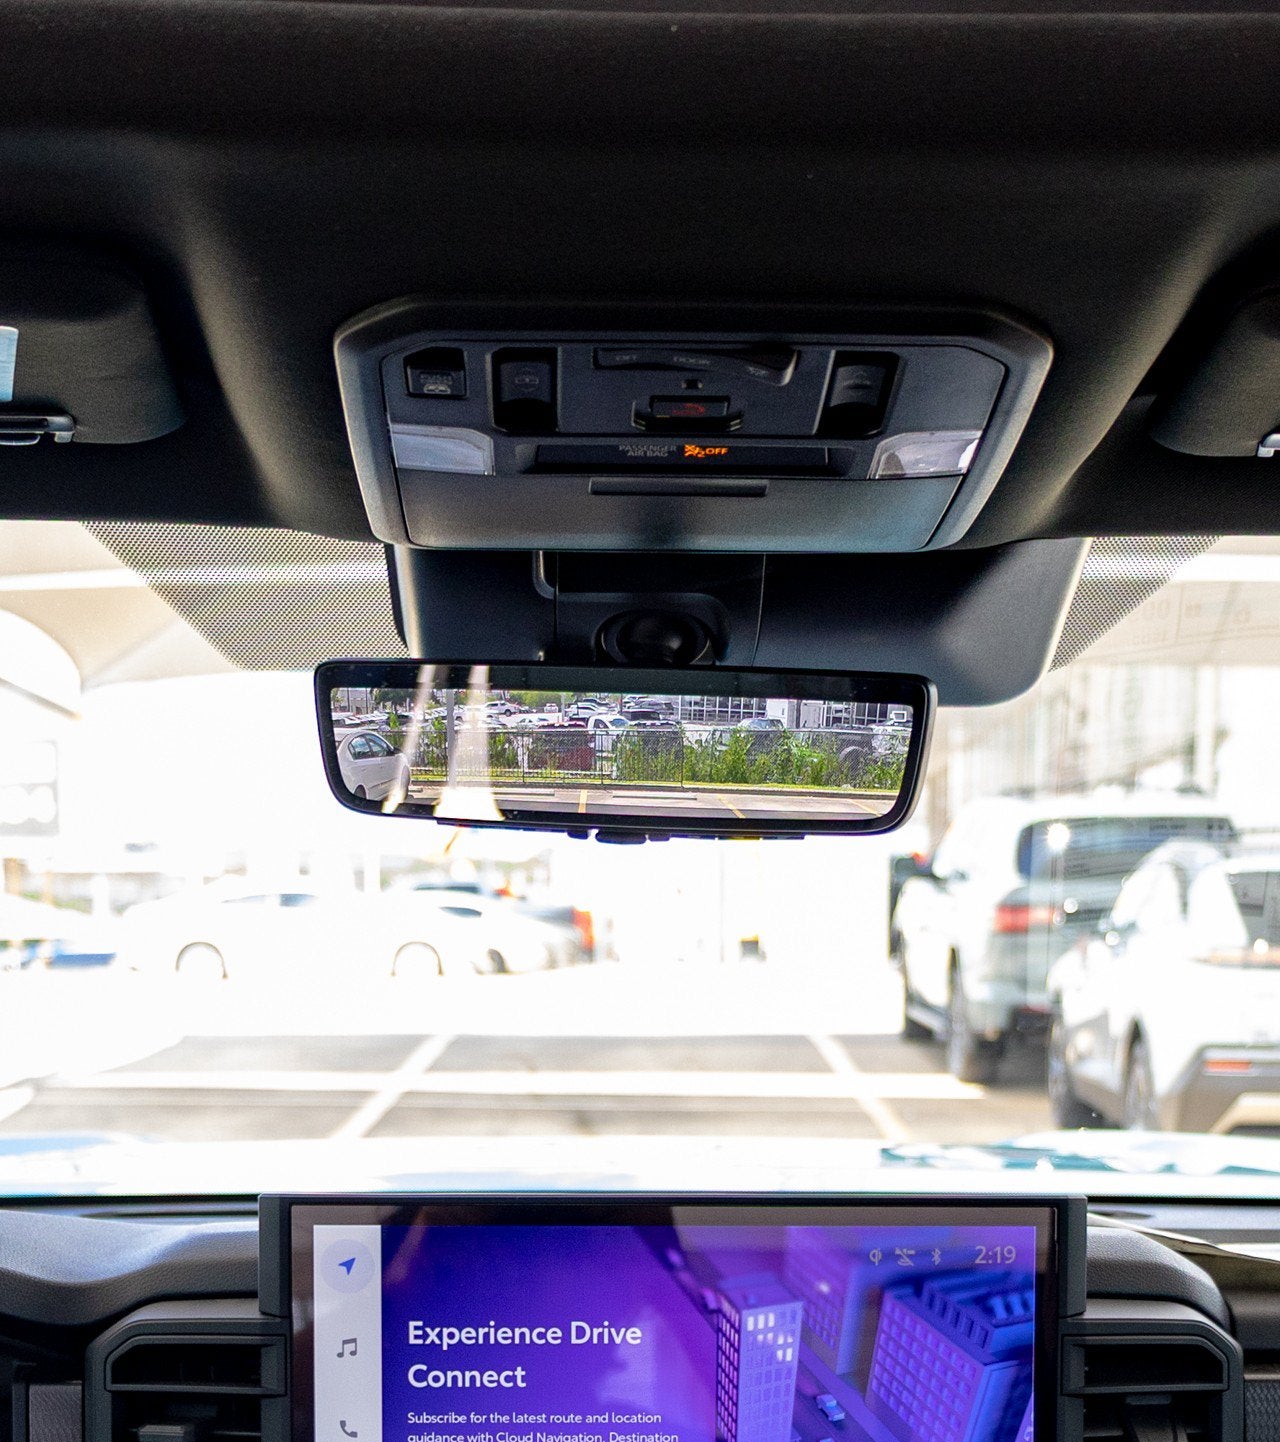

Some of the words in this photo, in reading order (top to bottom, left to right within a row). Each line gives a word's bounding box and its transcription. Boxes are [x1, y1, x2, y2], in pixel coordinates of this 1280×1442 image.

[619, 444, 677, 452] PASSENGER
[705, 447, 729, 455] OFF
[973, 1244, 1018, 1266] 2:19
[407, 1320, 563, 1351] Experience
[570, 1320, 643, 1345] Drive
[407, 1363, 527, 1388] Connect
[407, 1411, 468, 1424] Subscribe
[469, 1411, 487, 1424] for
[489, 1411, 510, 1424] the
[512, 1411, 547, 1424] latest
[550, 1412, 583, 1424] route
[585, 1411, 609, 1424] and
[611, 1411, 662, 1424] location
